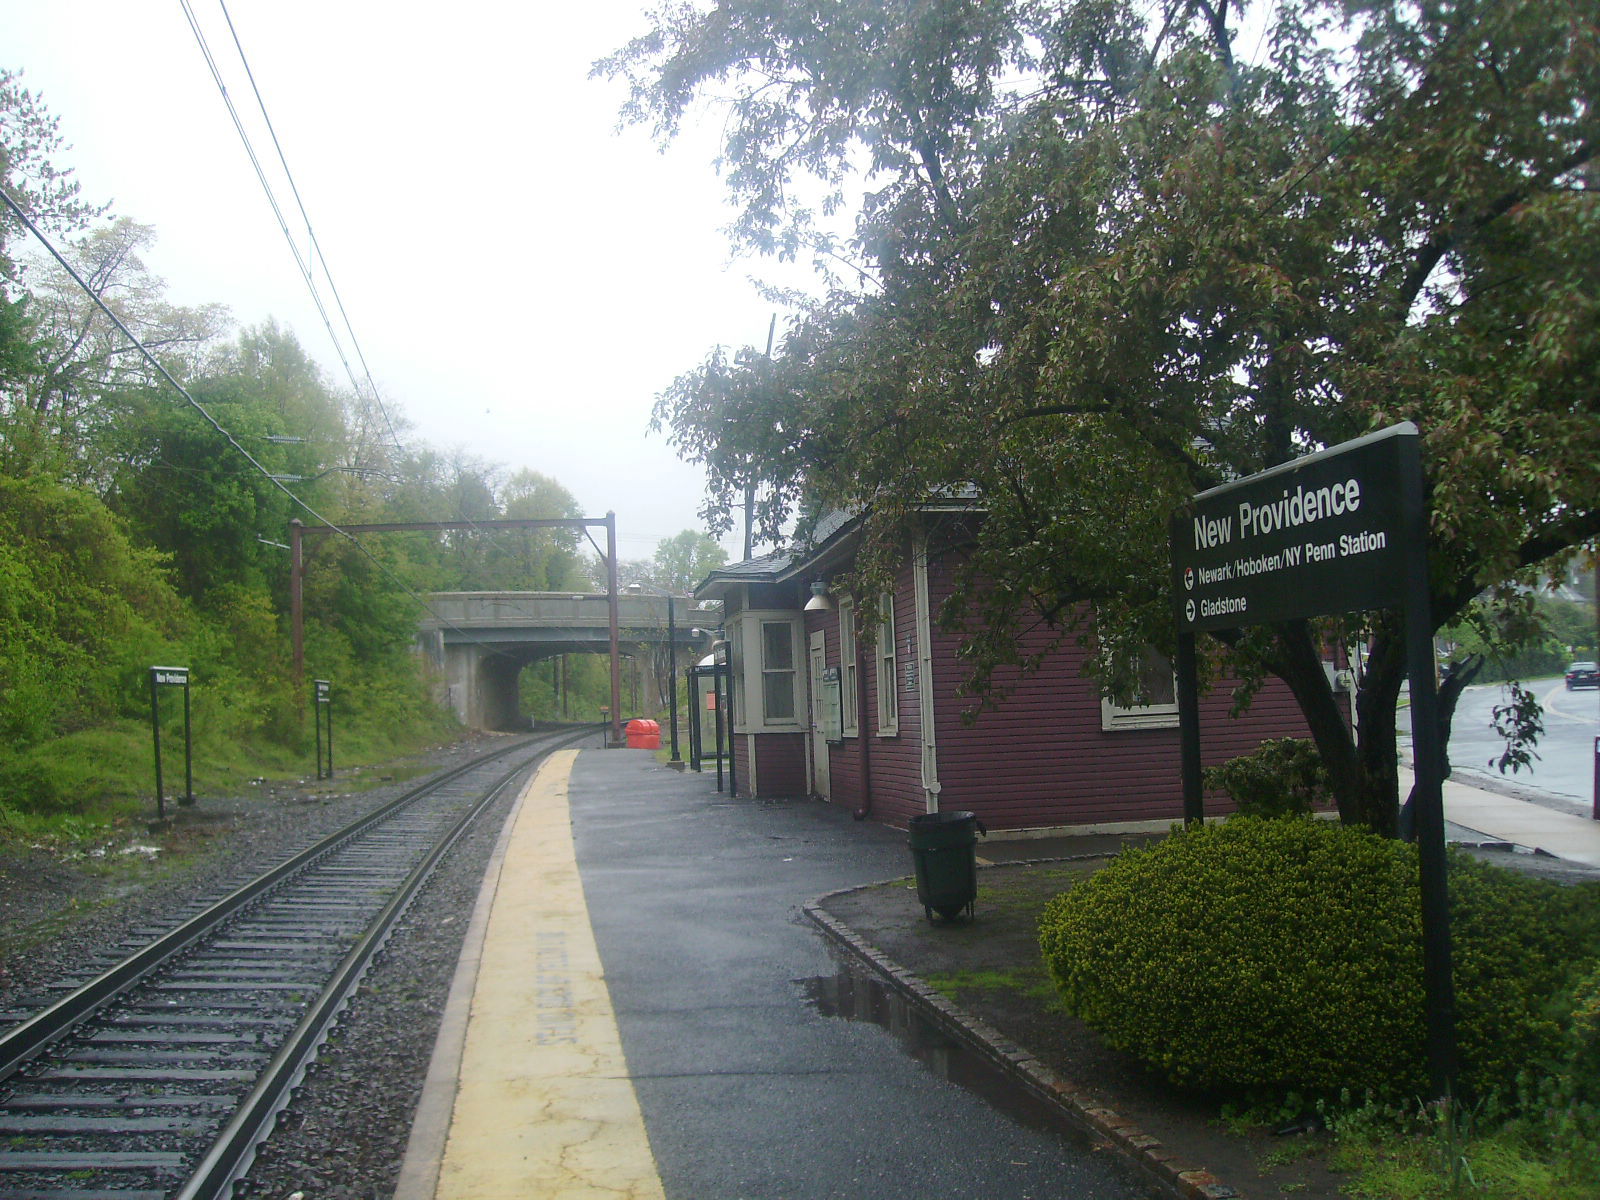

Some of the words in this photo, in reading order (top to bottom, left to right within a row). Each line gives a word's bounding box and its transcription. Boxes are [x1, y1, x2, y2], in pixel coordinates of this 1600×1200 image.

[1194, 516, 1231, 550] New
[1239, 479, 1360, 539] Providence
[1199, 546, 1301, 584] Newark/Hoboken/NY
[1306, 542, 1336, 564] Penn
[1340, 531, 1386, 557] Station
[1201, 596, 1247, 616] Gladstone
